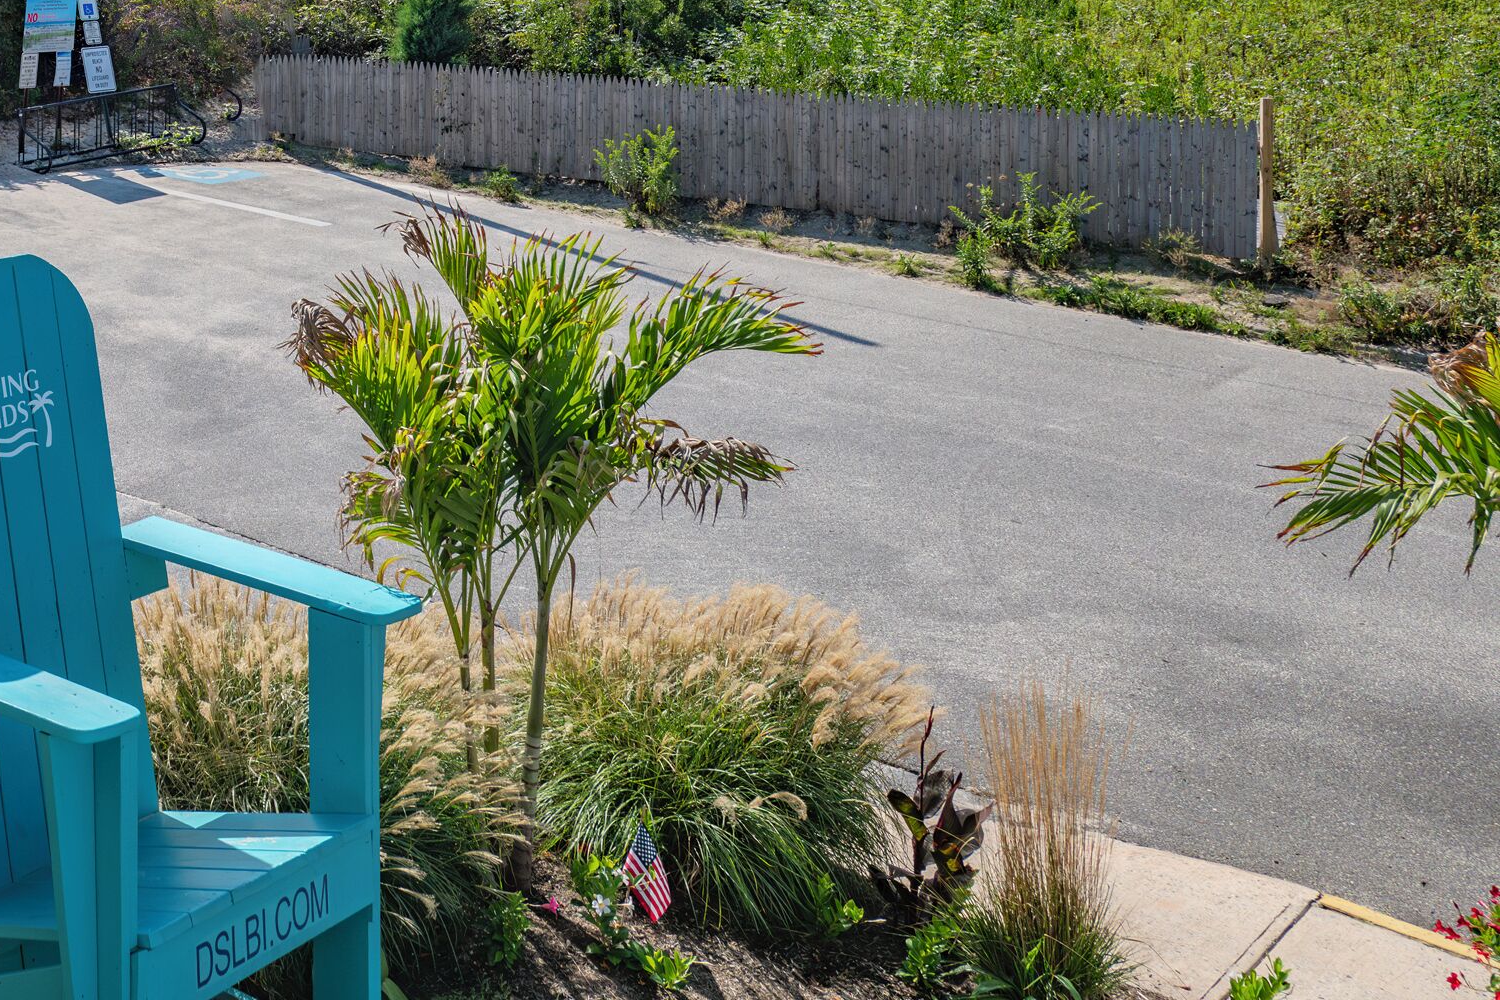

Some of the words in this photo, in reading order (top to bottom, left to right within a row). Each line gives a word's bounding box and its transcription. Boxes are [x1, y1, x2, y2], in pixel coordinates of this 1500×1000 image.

[27, 13, 39, 23] NO
[91, 74, 109, 82] LIFEGUARD
[195, 873, 329, 989] DSLBI.COM
